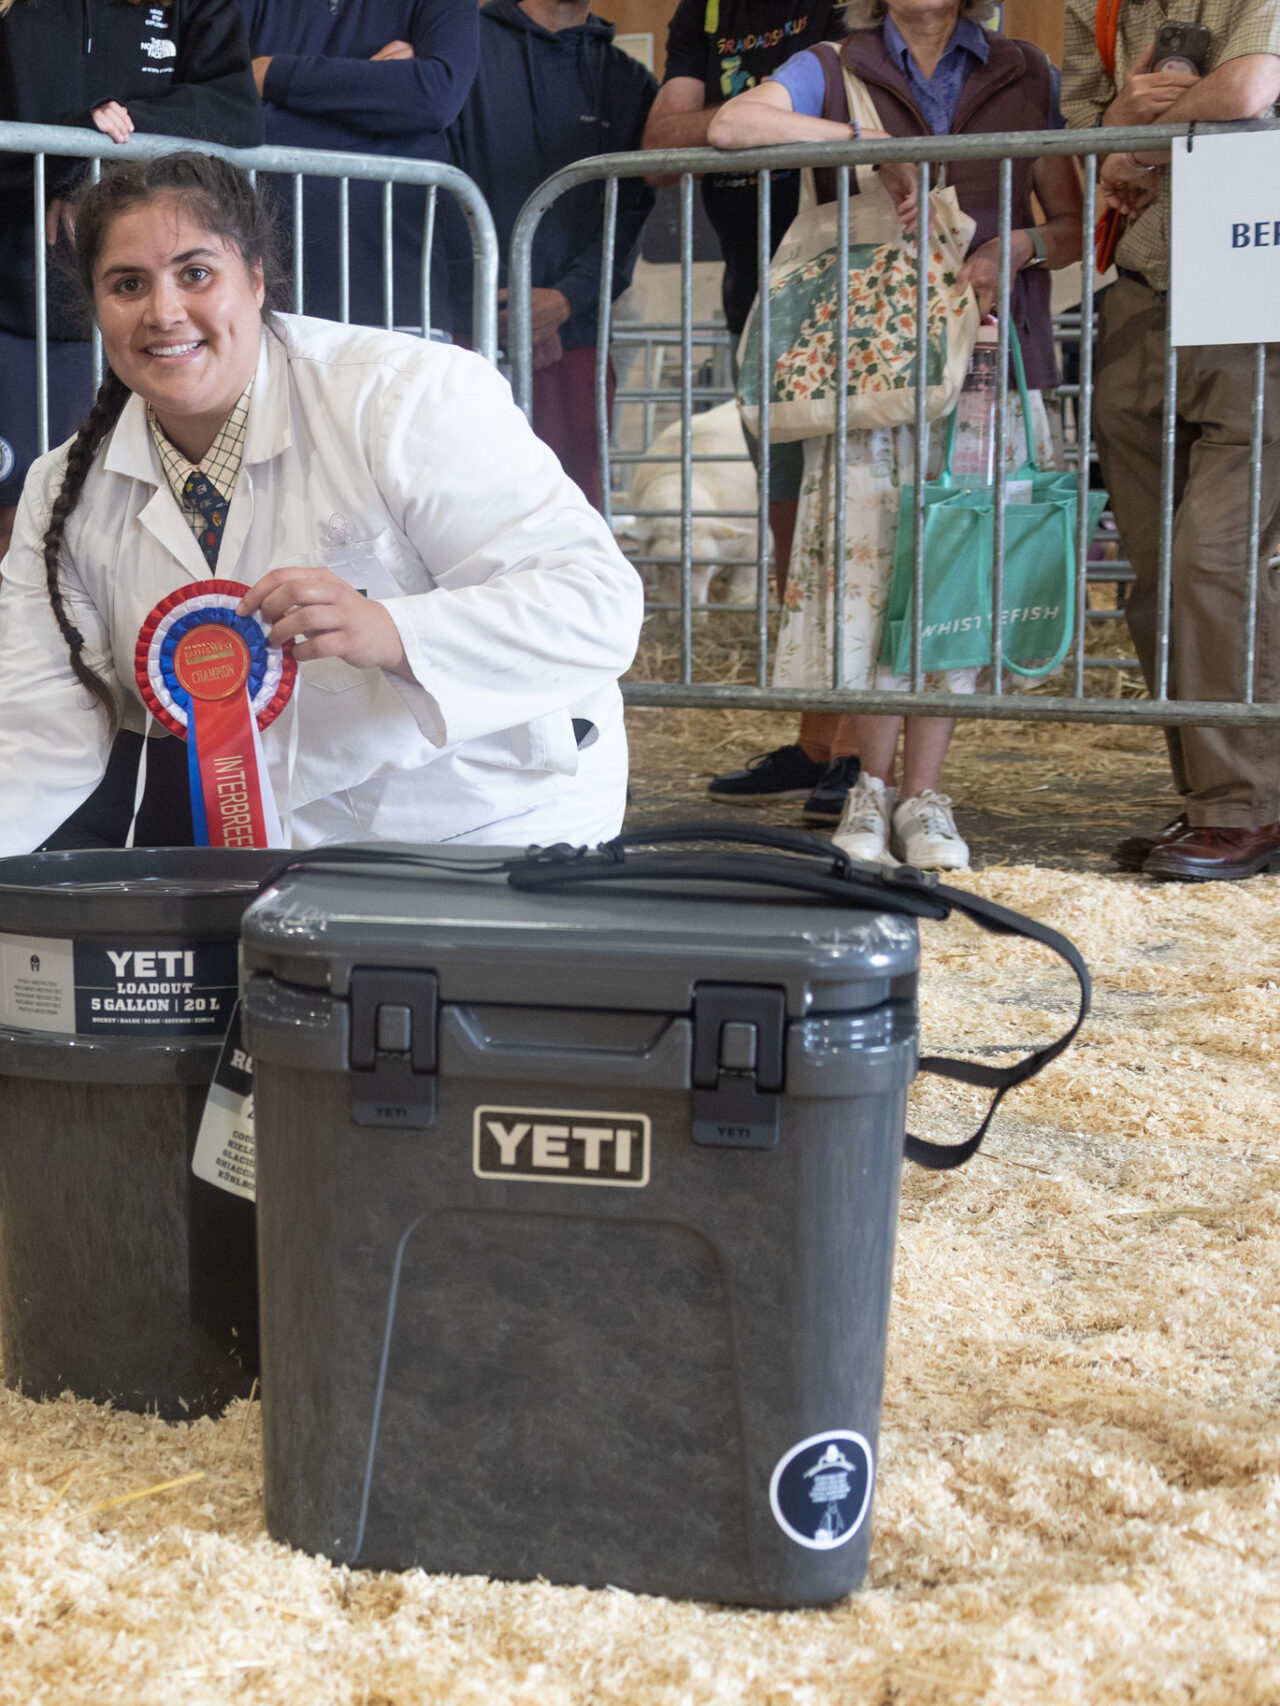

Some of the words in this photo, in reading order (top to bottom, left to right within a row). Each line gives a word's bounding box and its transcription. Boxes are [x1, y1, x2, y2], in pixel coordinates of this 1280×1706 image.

[213, 755, 254, 848] INTERBREE
[106, 950, 195, 978] YETI
[116, 981, 194, 995] LOADOUT
[91, 998, 101, 1011] 5
[104, 997, 170, 1012] GALLON
[183, 997, 206, 1011] 20
[210, 996, 220, 1011] L
[486, 1121, 632, 1172] YETI
